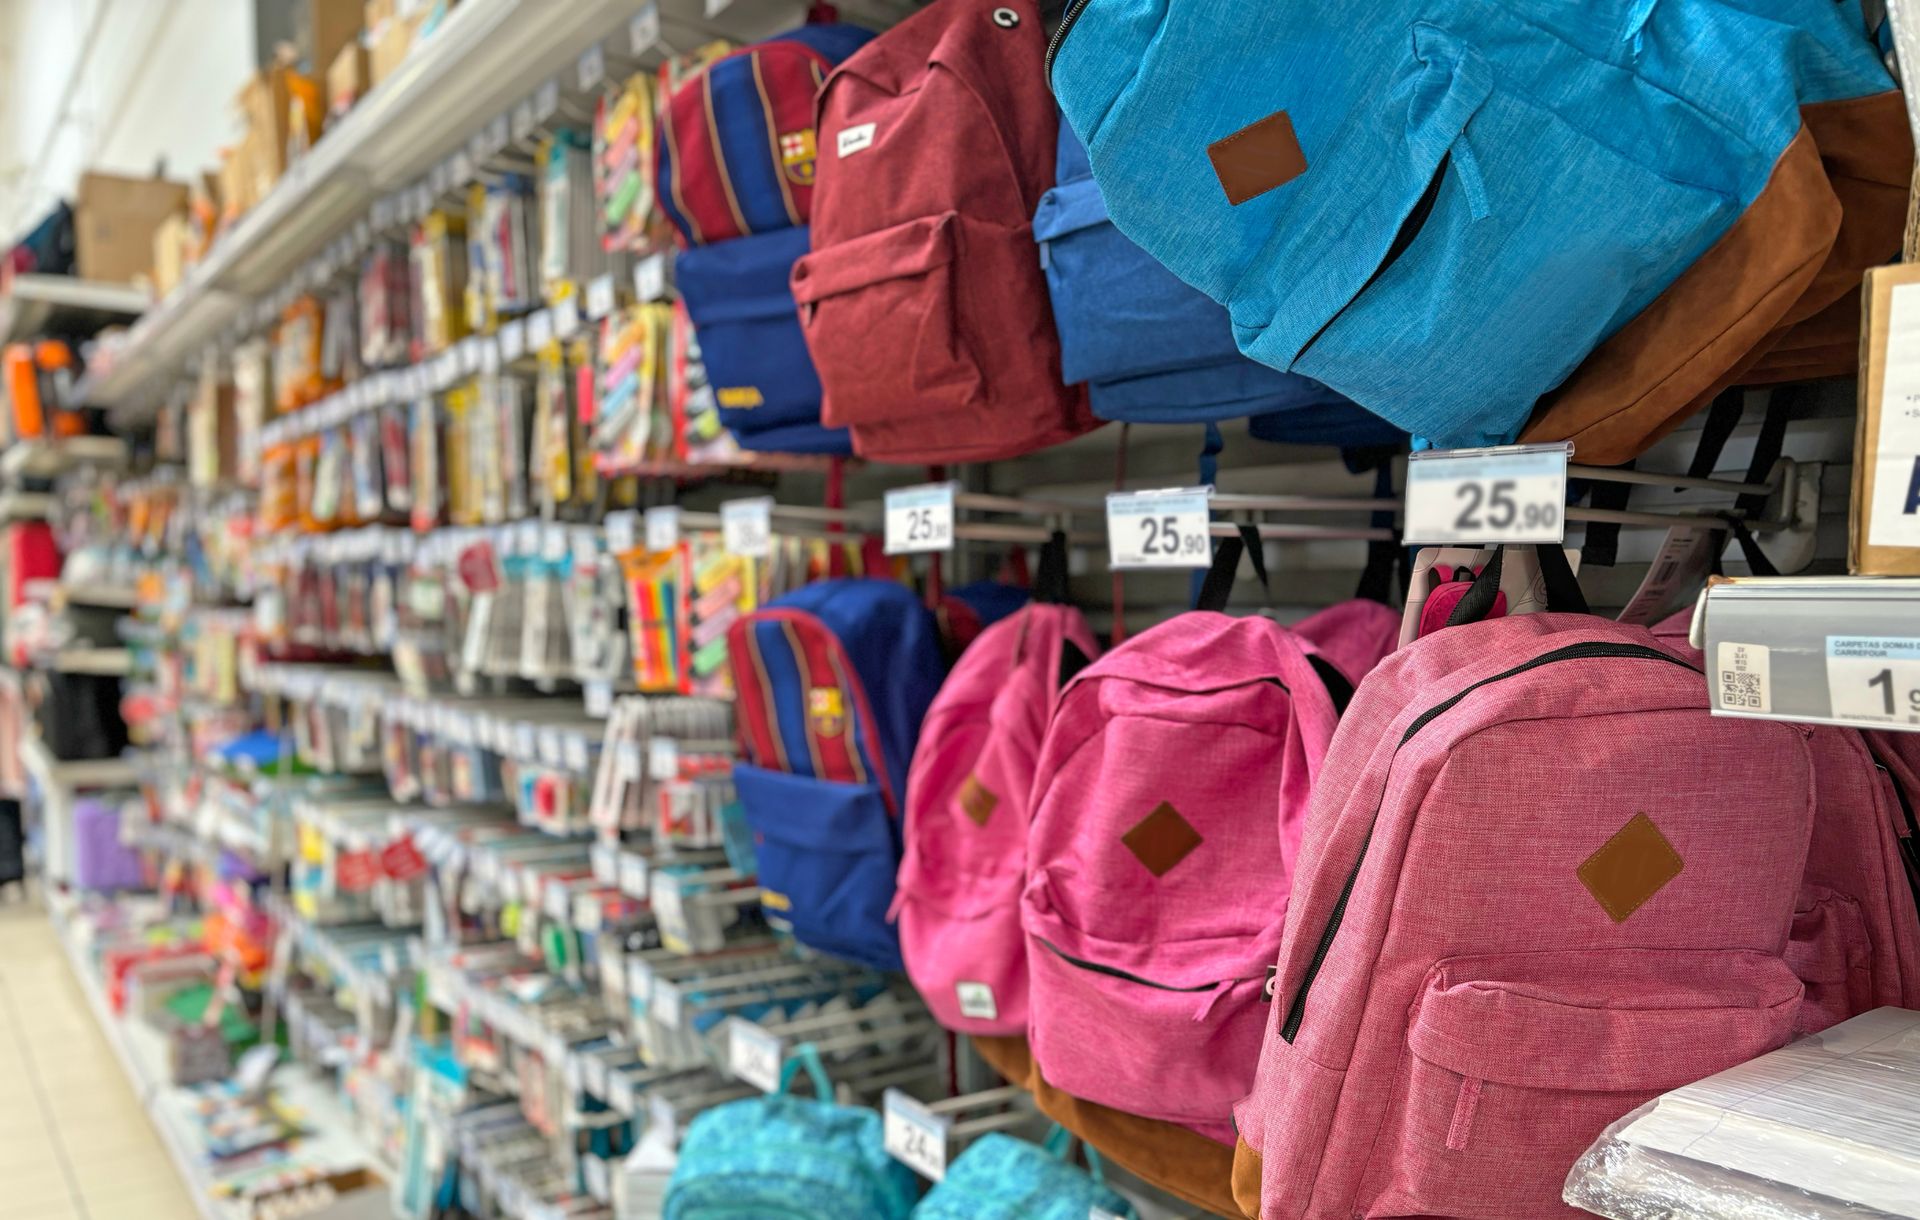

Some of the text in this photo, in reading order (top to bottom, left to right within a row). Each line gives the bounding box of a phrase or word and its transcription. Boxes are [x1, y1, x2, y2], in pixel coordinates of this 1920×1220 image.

[1454, 481, 1557, 532] 25,90
[1140, 516, 1205, 556] 25,90
[1834, 640, 1880, 649] CARPETAS
[1882, 641, 1915, 650] GOMAS
[1834, 649, 1888, 657] CARREFOUR
